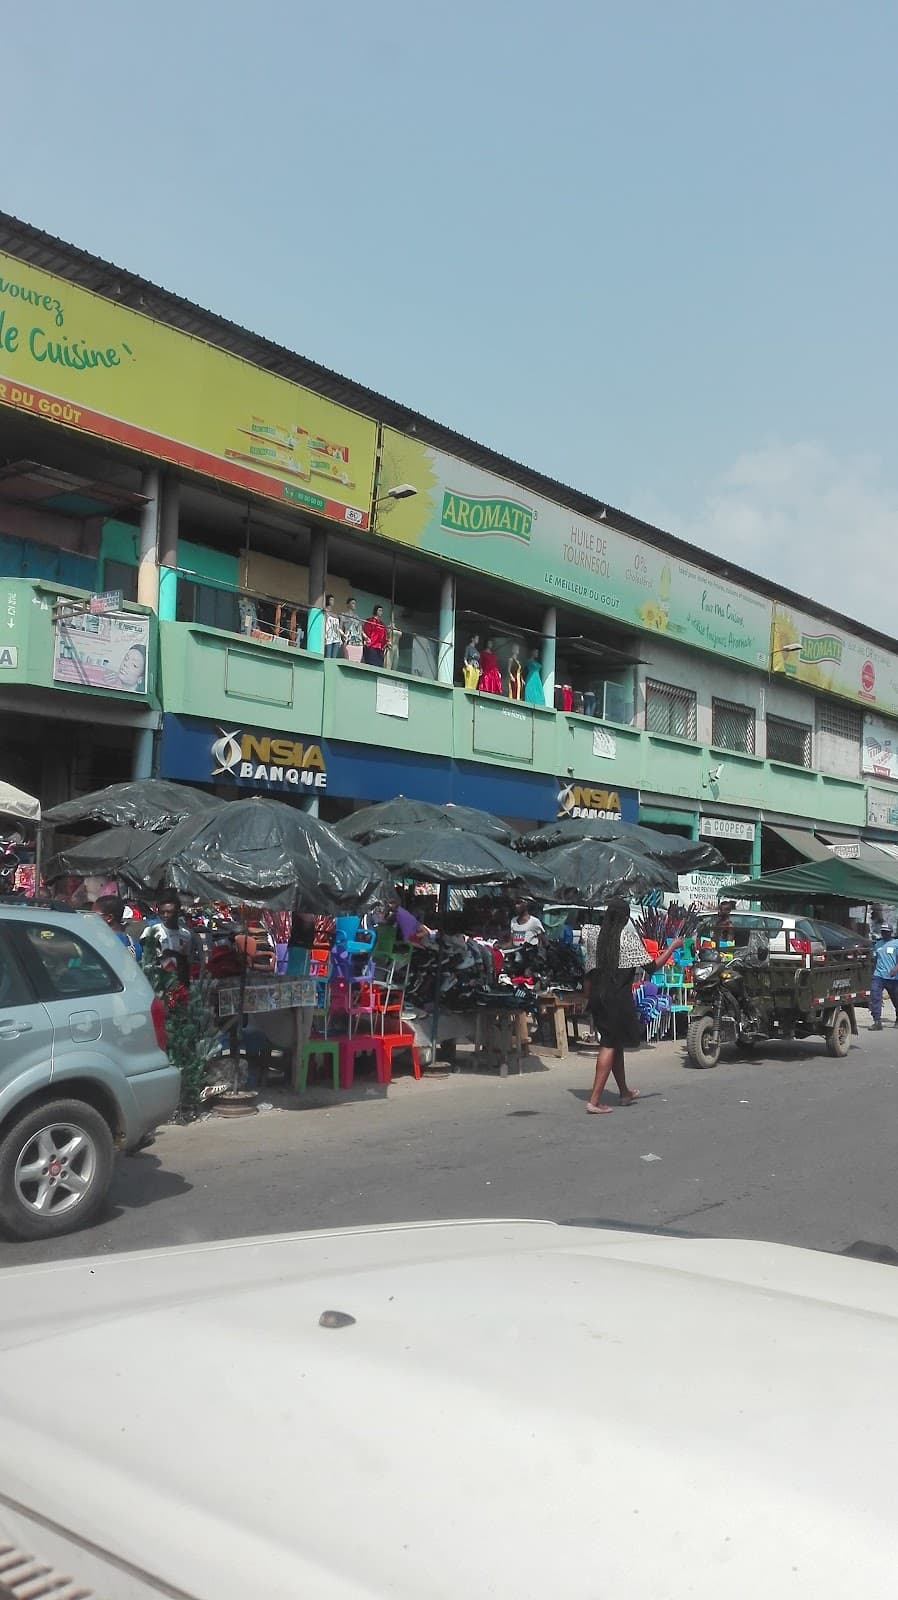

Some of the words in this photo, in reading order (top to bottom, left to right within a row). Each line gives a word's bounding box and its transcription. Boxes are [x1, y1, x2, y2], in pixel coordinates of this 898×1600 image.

[11, 388, 34, 407] DU
[38, 404, 82, 423] GOÛT
[442, 495, 532, 537] AROMATE
[571, 526, 594, 551] HUILE
[596, 538, 607, 556] DE
[563, 543, 611, 579] TOURNESOL
[544, 572, 553, 584] LE
[554, 577, 588, 597] MEILLEUR
[589, 589, 599, 601] DU
[241, 733, 326, 771] NSIA
[240, 762, 327, 788] BANQUE
[573, 786, 621, 811] NSIA
[572, 806, 622, 821] BANQUE
[714, 820, 745, 834] COOPEC
